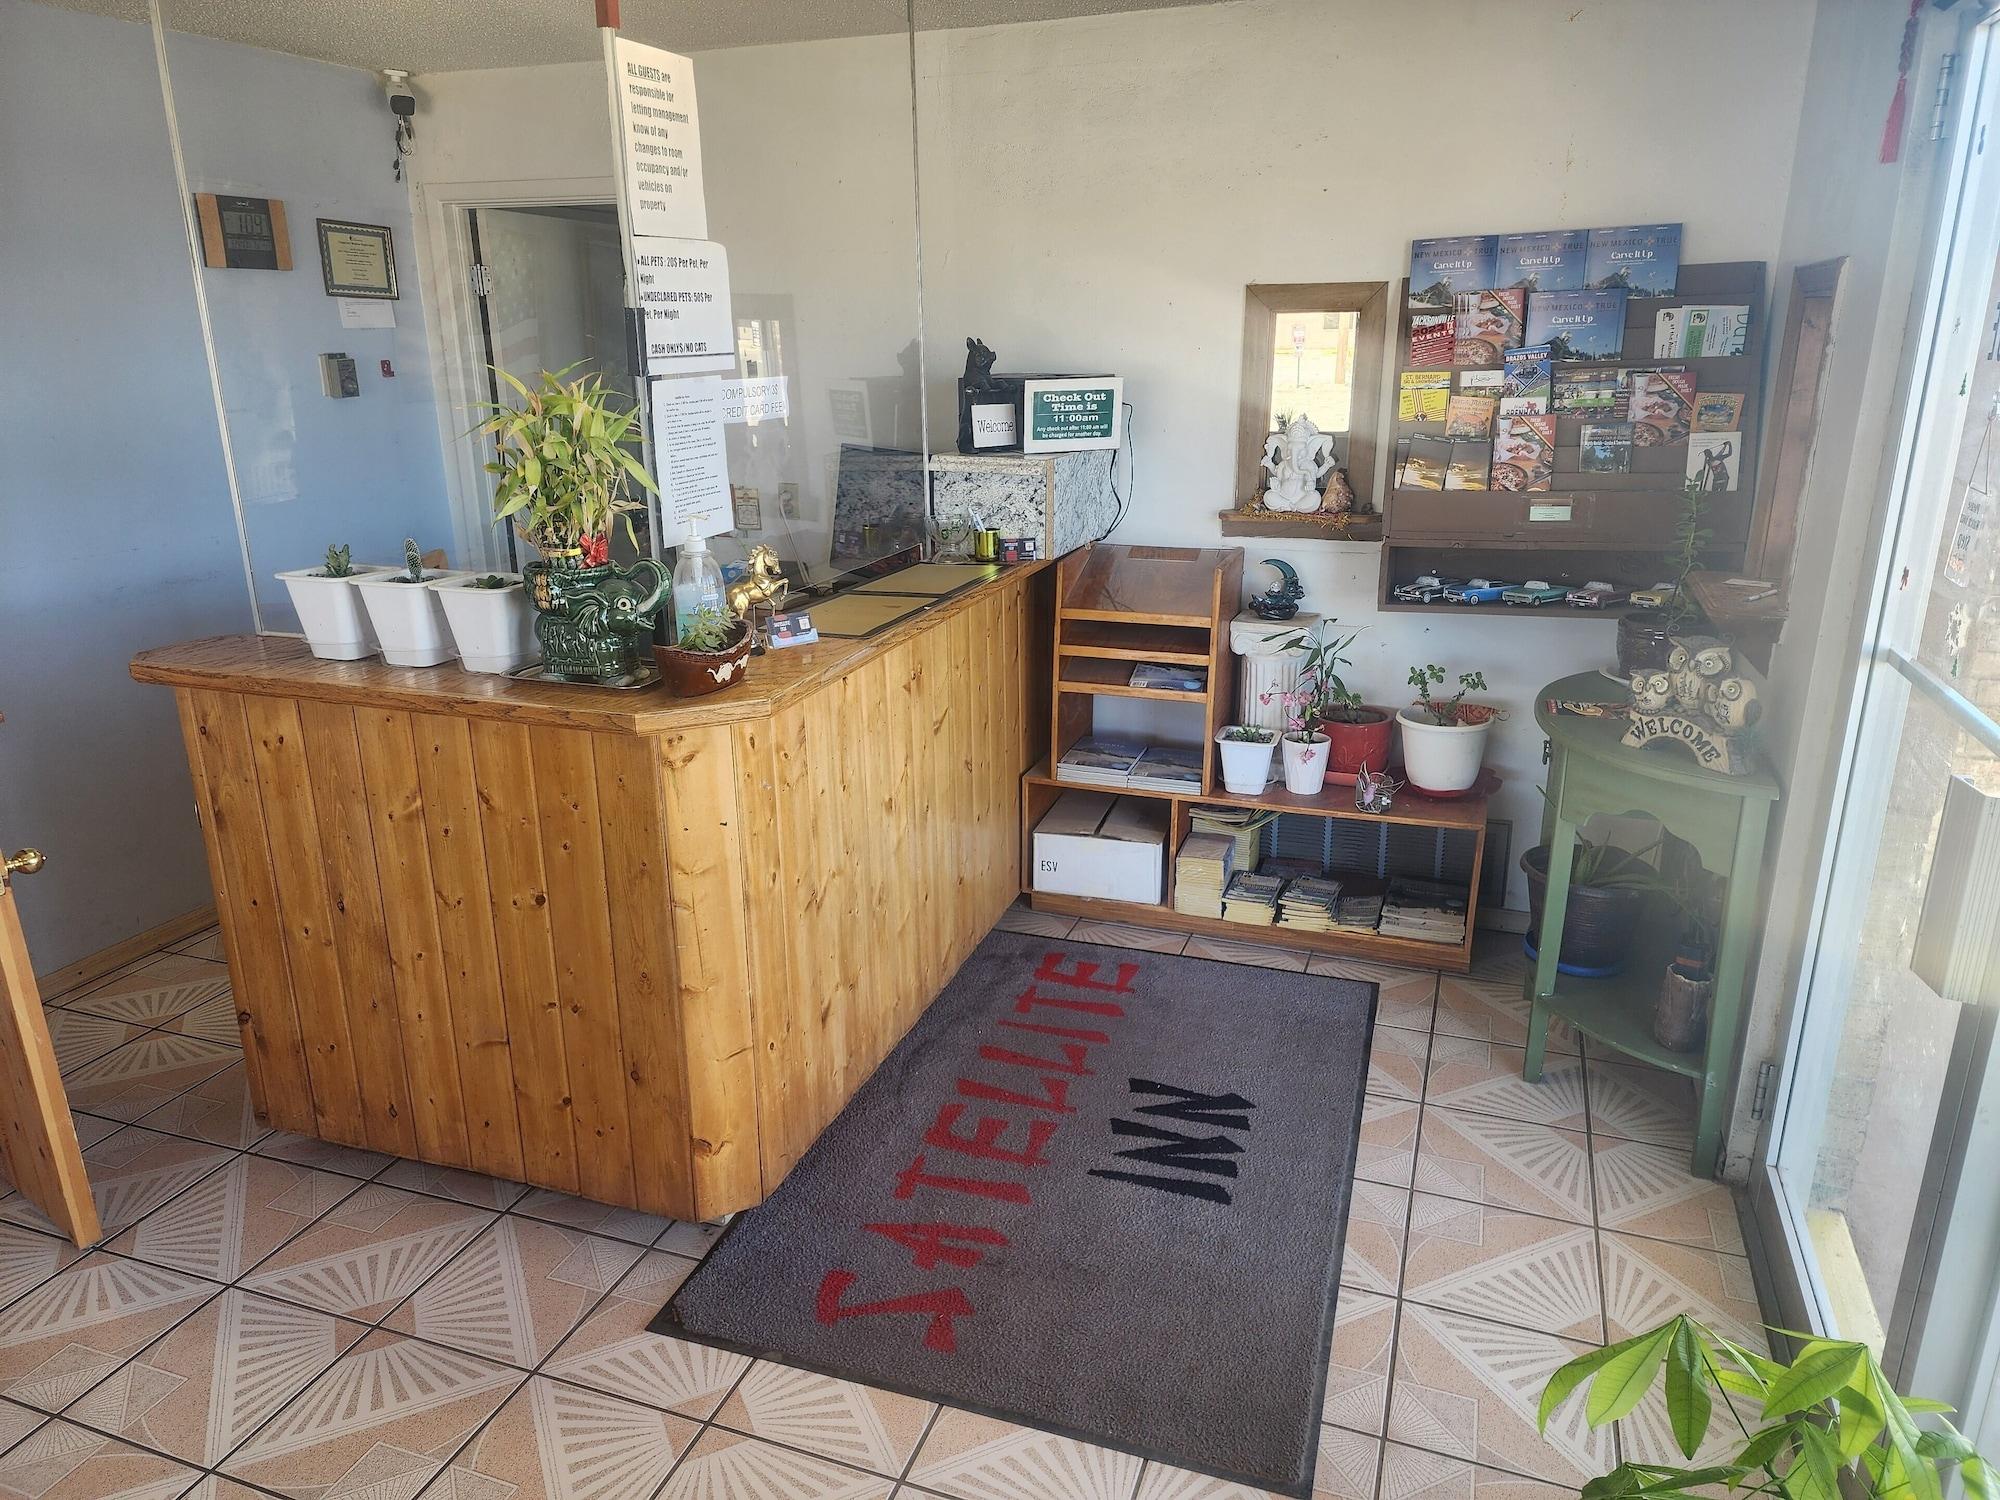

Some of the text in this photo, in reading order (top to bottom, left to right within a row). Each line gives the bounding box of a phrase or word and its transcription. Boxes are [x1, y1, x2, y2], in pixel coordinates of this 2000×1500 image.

[627, 62, 671, 83] ALL GUESTS are
[629, 84, 674, 102] responsible for
[631, 101, 689, 124] letting management
[633, 121, 669, 139] know of any
[634, 141, 683, 159] changes to room
[636, 162, 688, 178] occupancy and/or
[638, 180, 673, 194] vehicles on
[640, 200, 666, 212] property
[1414, 251, 1430, 259] NEW
[1433, 249, 1462, 257] MEXICO
[1550, 256, 1560, 264] Up
[1642, 250, 1653, 259] Up
[641, 256, 650, 266] ALL
[651, 256, 663, 267] PETS
[678, 258, 688, 268] Per
[700, 259, 709, 269] Per
[640, 274, 654, 285] Night
[644, 292, 677, 302] UNDECLARED
[704, 292, 713, 303] Per
[1552, 303, 1582, 312] MEXICO
[654, 309, 663, 320] Per
[664, 309, 680, 320] Night
[1412, 314, 1455, 328] JACKSONVILLE
[1583, 314, 1593, 322] Up
[1412, 330, 1454, 343] EVENTS
[651, 343, 666, 354] CASH
[694, 342, 707, 352] CATS
[1043, 392, 1107, 402] Check Out
[750, 404, 769, 416] CARD
[771, 402, 783, 413] FEE
[1052, 402, 1097, 412] Time is
[1053, 414, 1099, 422] 11:00am
[977, 419, 1014, 433] Welcome
[1630, 717, 1721, 762] WELCOME
[1041, 860, 1058, 872] ESV
[1087, 1077, 1257, 1206] INN
[816, 952, 1140, 1354] SATELLITE
